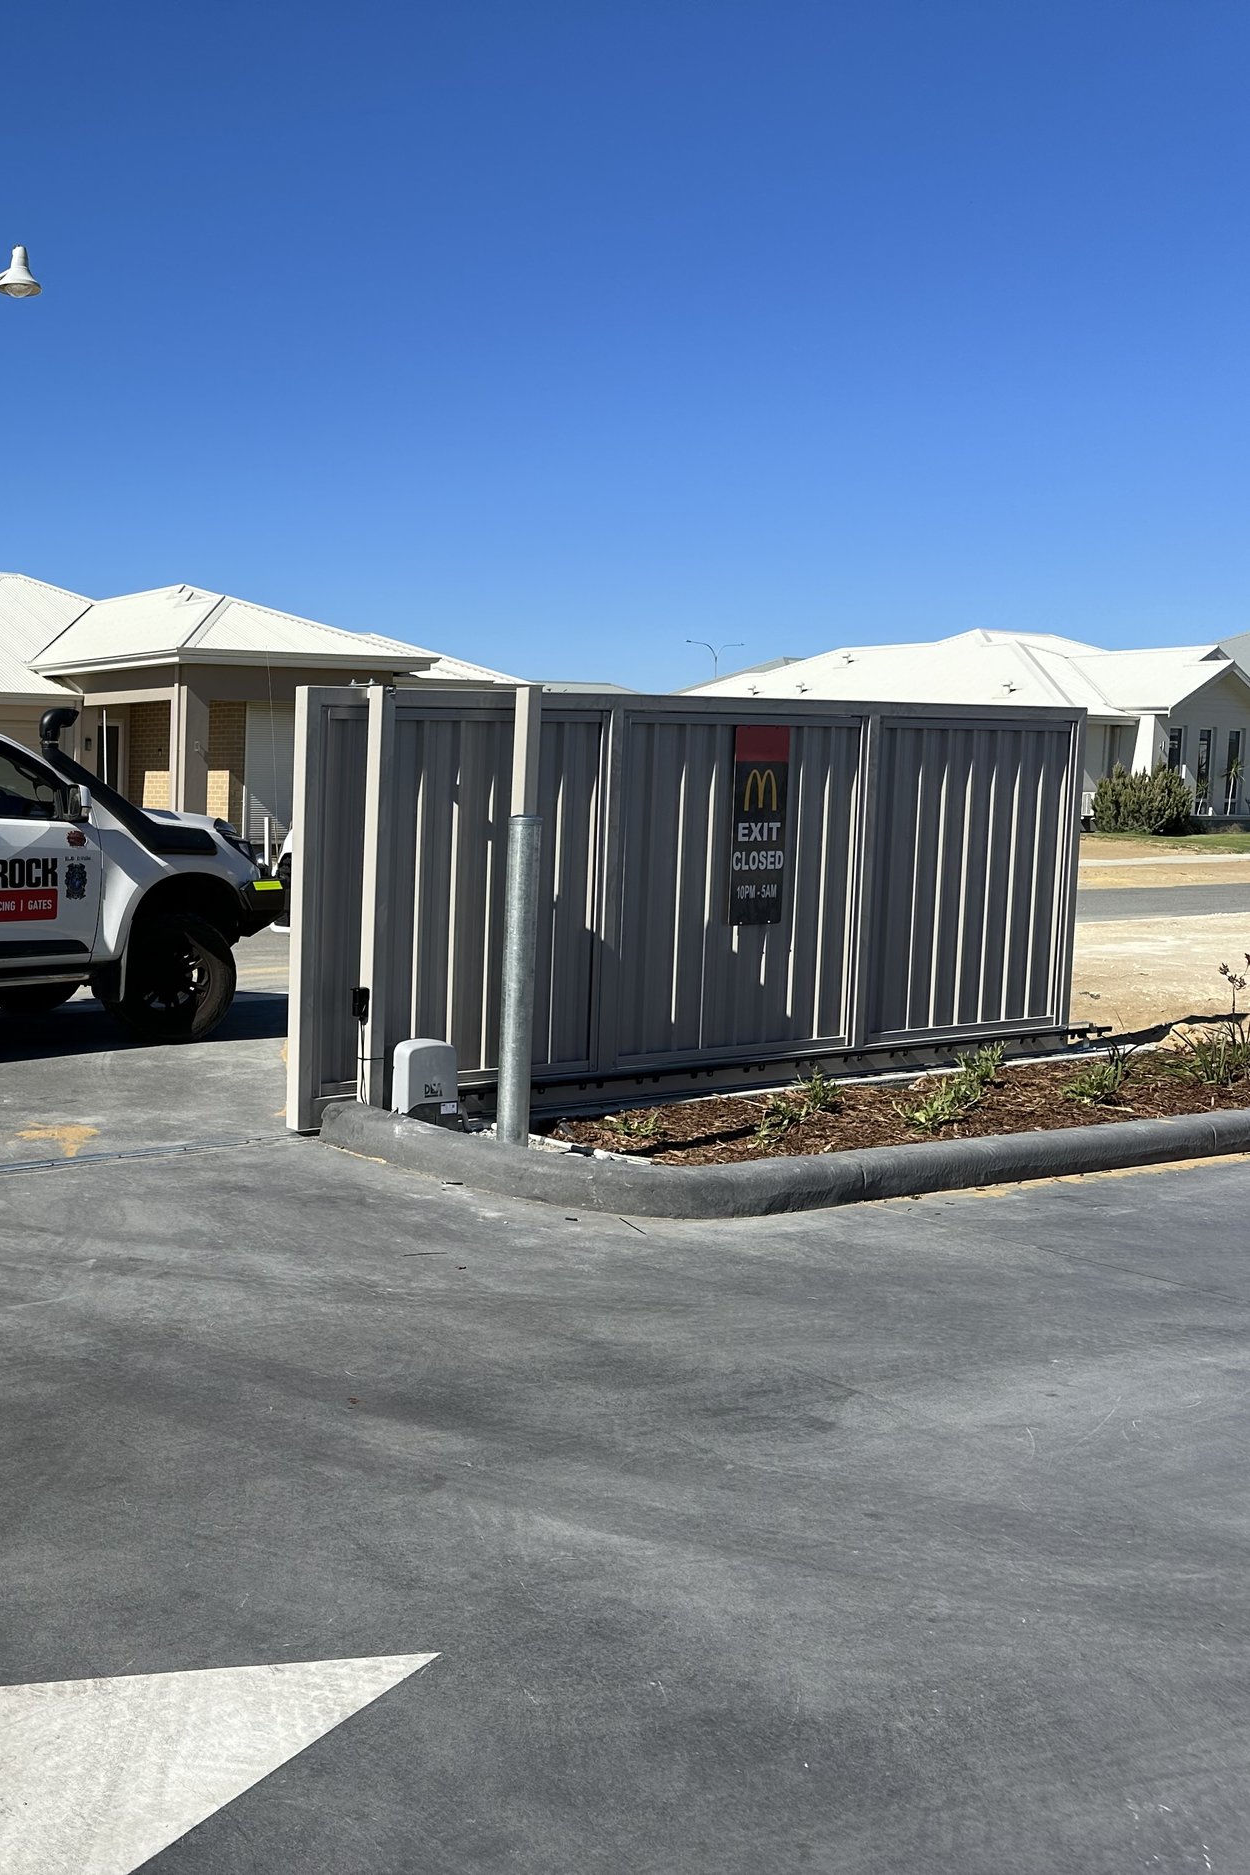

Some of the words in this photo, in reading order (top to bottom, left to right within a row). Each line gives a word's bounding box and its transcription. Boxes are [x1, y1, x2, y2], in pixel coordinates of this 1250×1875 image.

[738, 822, 781, 841] EXIT
[733, 851, 784, 871] CLOSED
[737, 885, 755, 899] 10PM
[761, 884, 777, 898] 5AM
[28, 900, 53, 910] GATES
